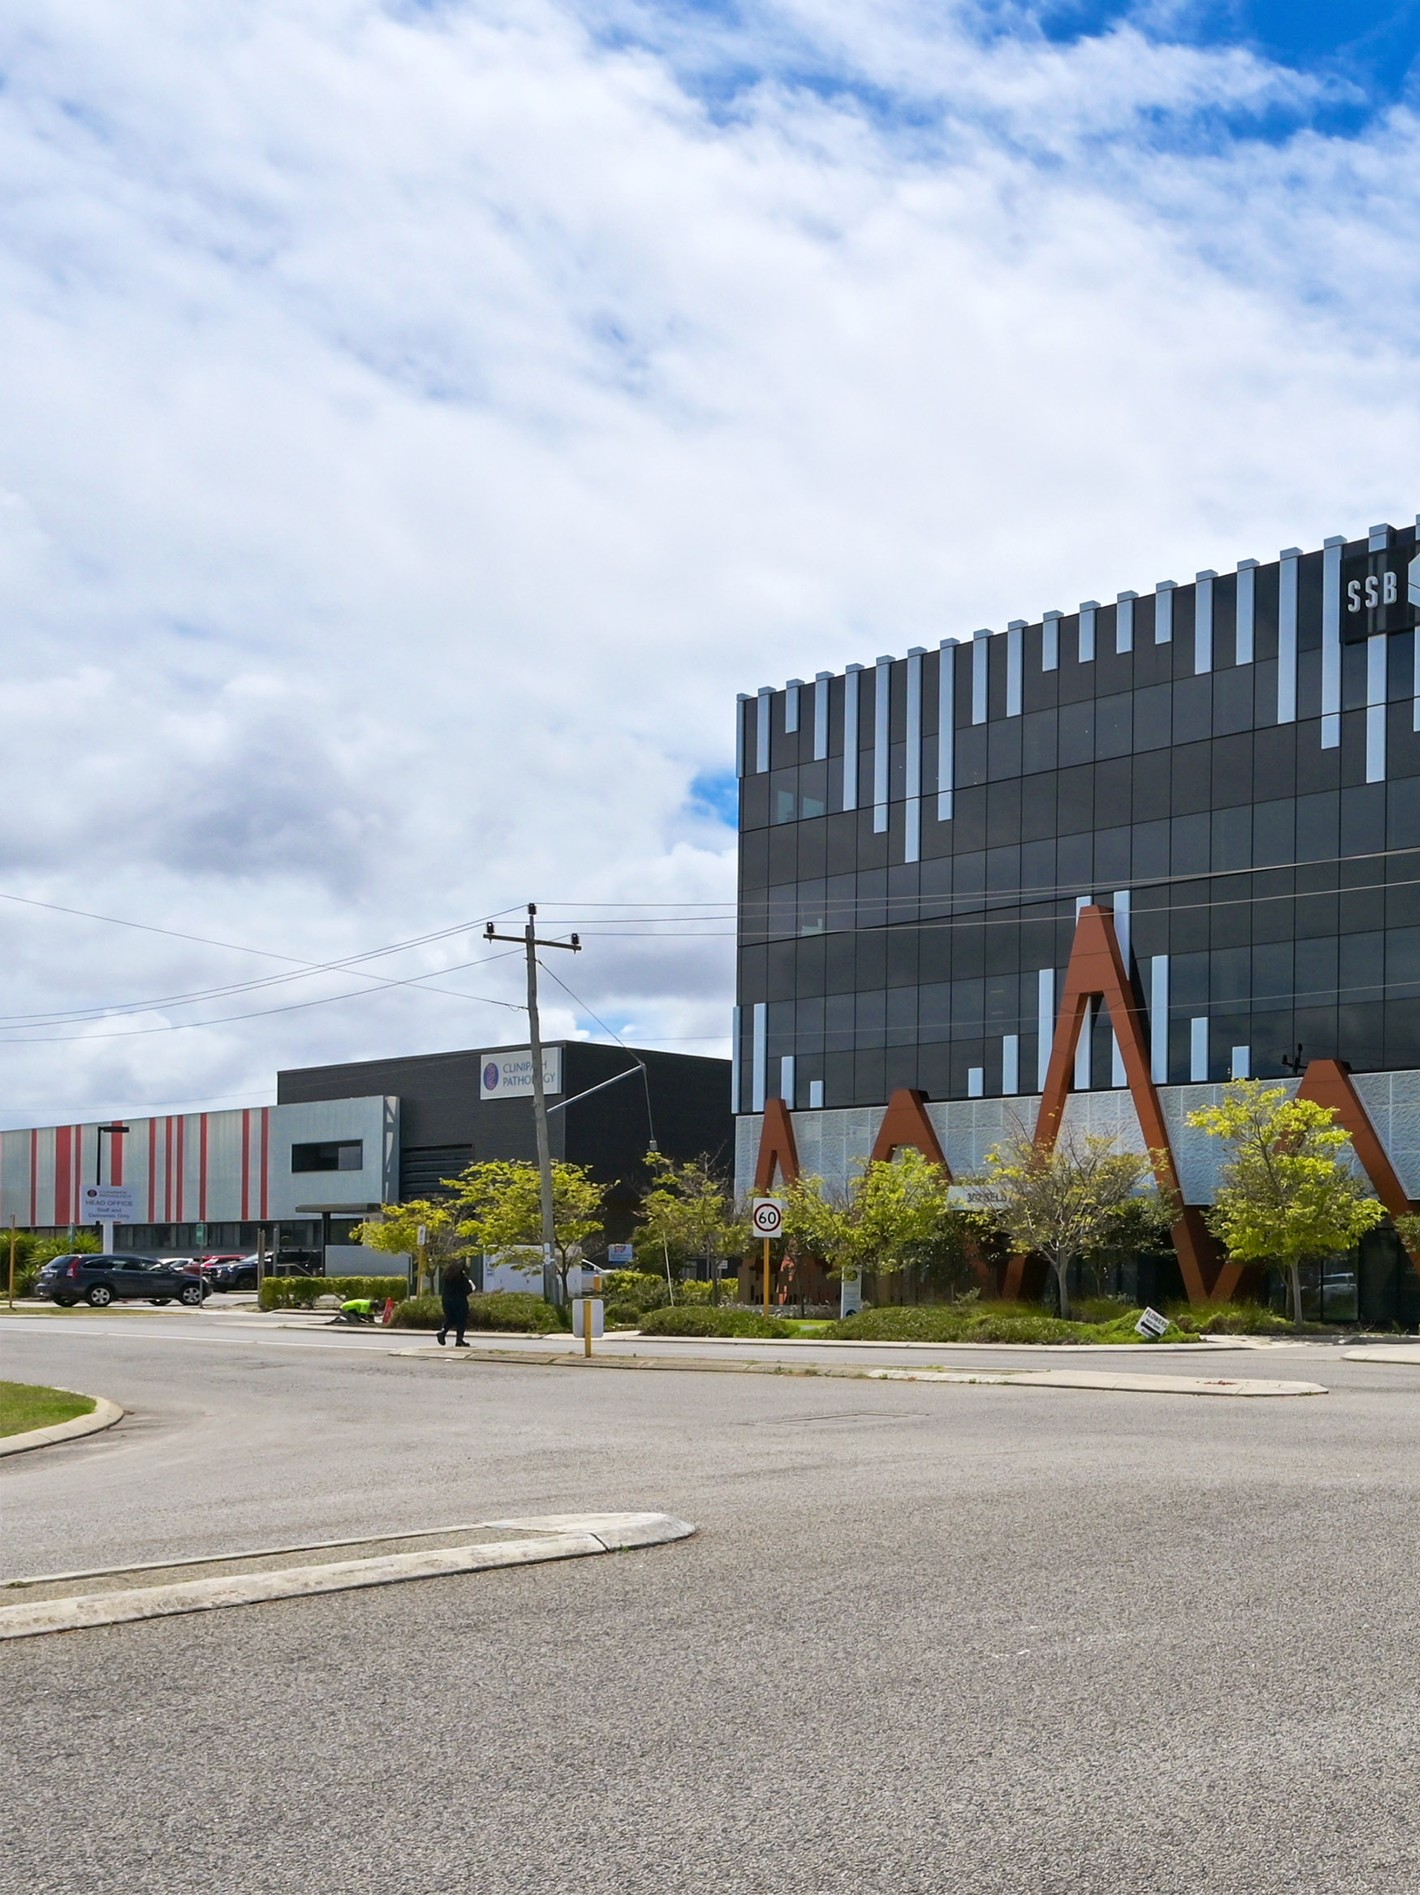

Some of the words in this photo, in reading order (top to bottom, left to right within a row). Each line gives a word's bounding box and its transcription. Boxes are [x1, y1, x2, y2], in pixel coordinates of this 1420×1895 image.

[1347, 571, 1397, 613] SSB
[502, 1061, 547, 1073] CLINIPH
[503, 1072, 555, 1086] PATHOGY
[759, 1211, 776, 1224] 60
